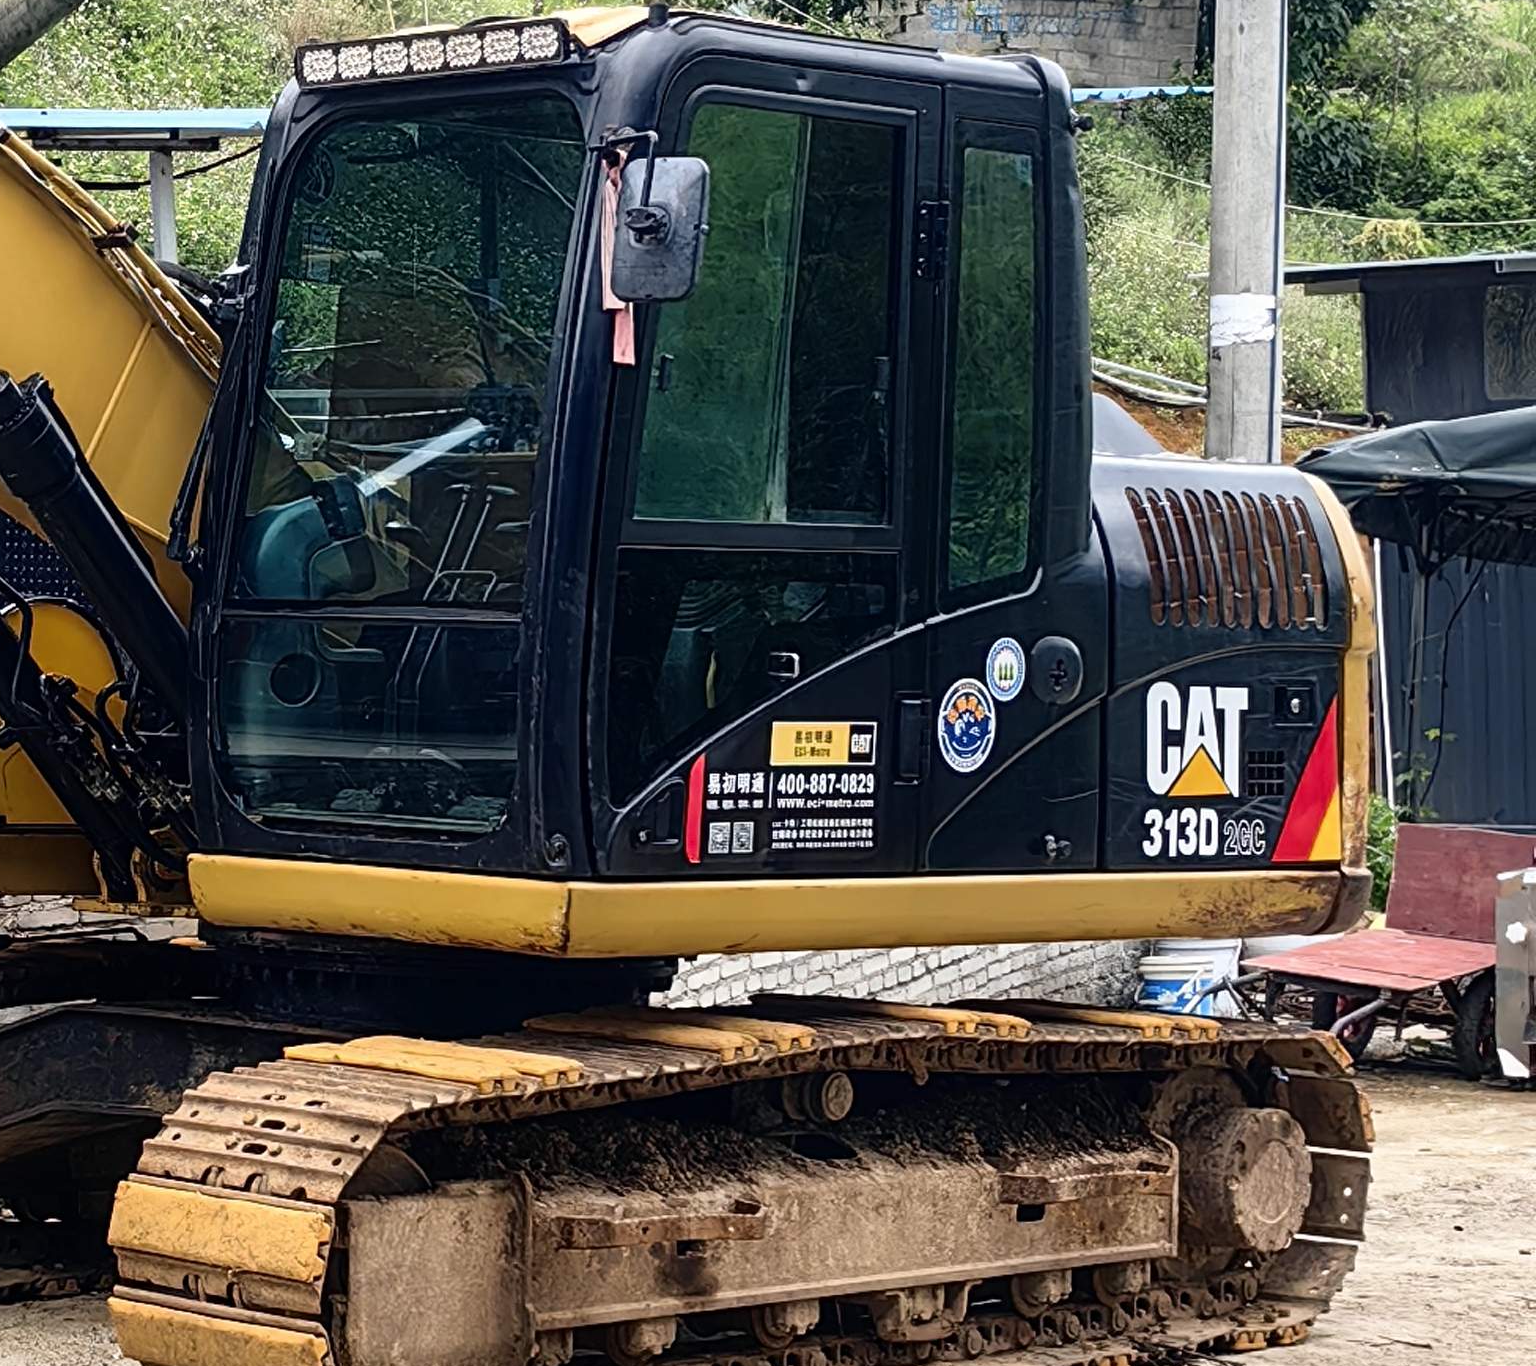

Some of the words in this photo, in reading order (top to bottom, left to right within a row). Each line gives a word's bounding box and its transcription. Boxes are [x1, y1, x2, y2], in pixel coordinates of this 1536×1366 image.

[1146, 681, 1249, 797] CAT
[707, 772, 764, 794] 易初明通
[777, 773, 874, 794] 400-887-0829
[1142, 807, 1219, 858] 313D
[1223, 819, 1265, 855] 2GC
